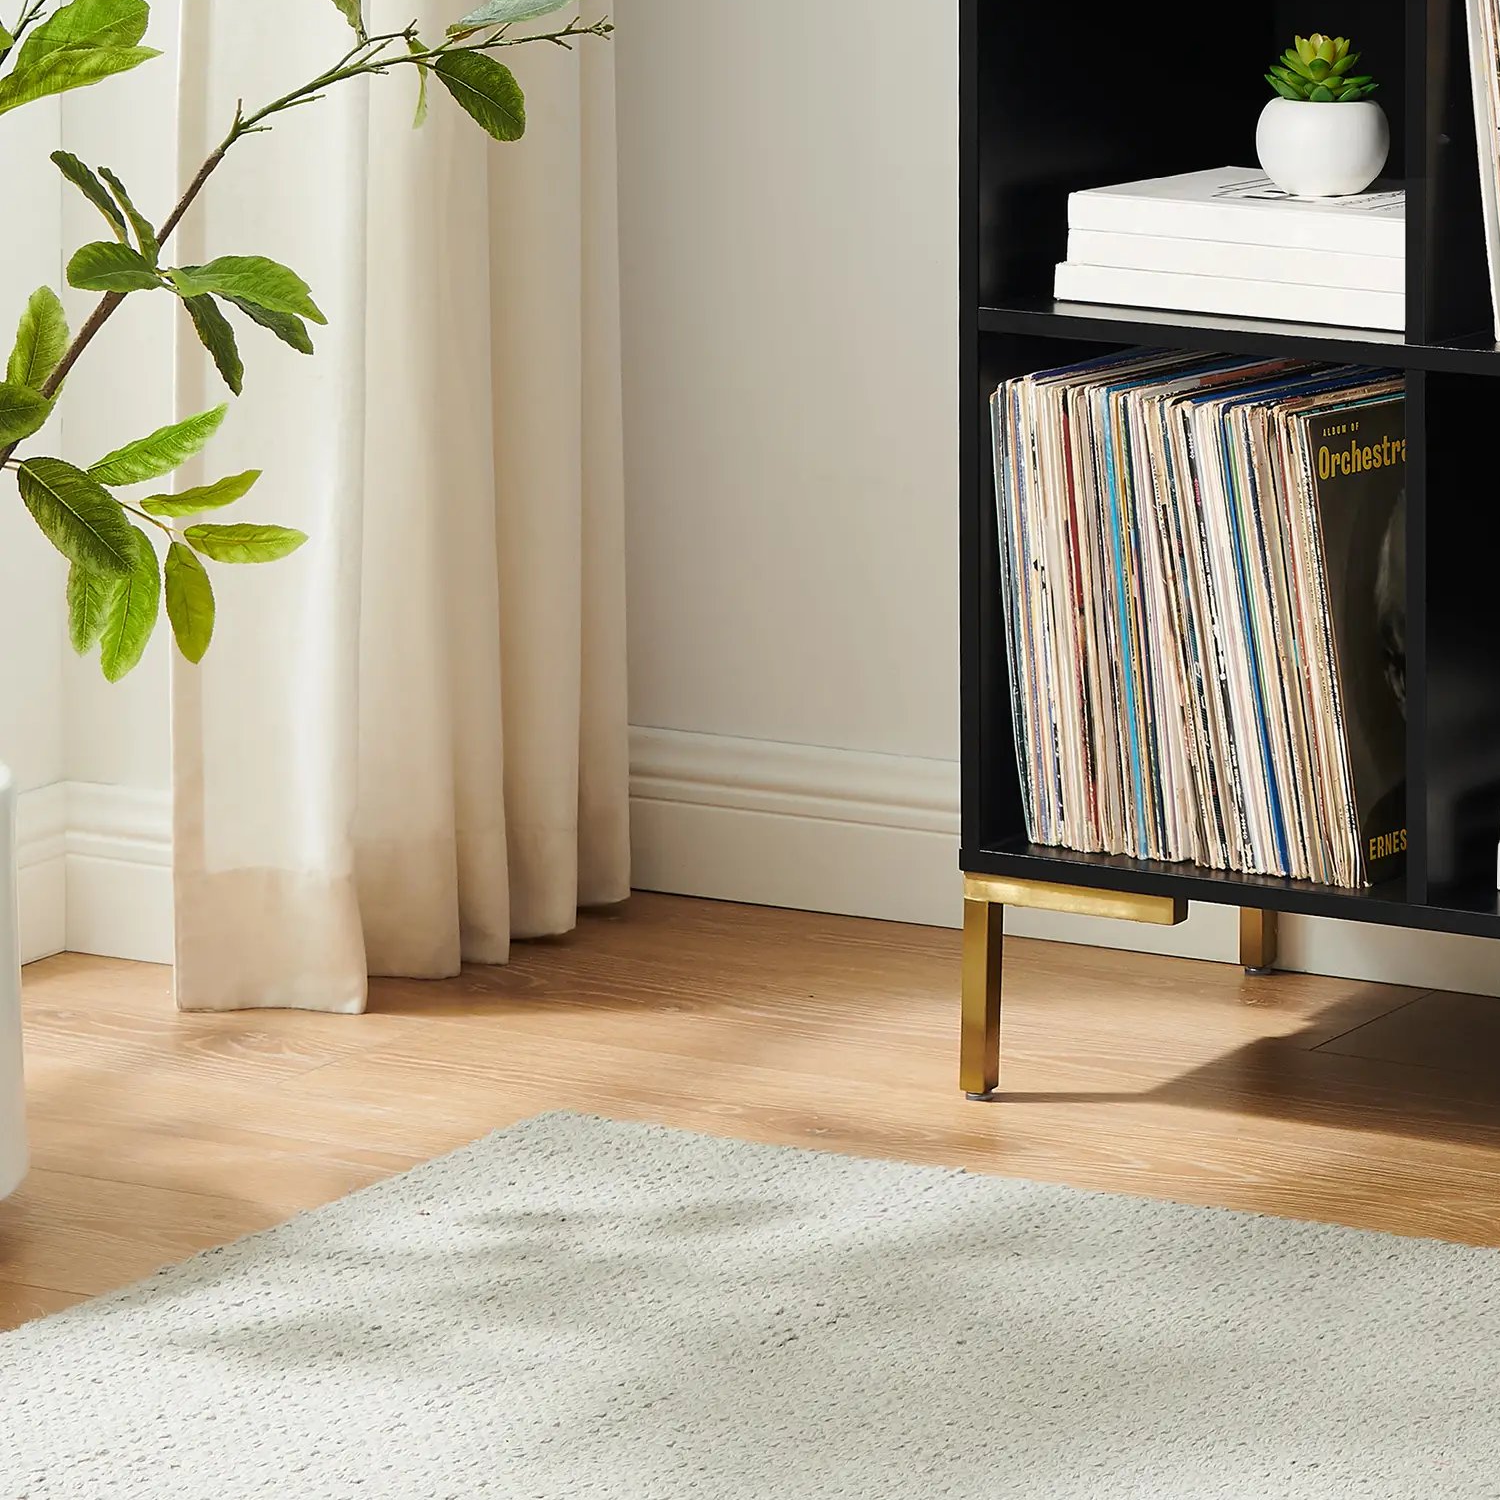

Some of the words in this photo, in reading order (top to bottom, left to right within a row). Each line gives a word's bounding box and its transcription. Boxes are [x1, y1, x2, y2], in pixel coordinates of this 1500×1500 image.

[1322, 425, 1347, 437] ALBUM
[1351, 421, 1360, 431] OF
[1369, 828, 1407, 860] ERNES
